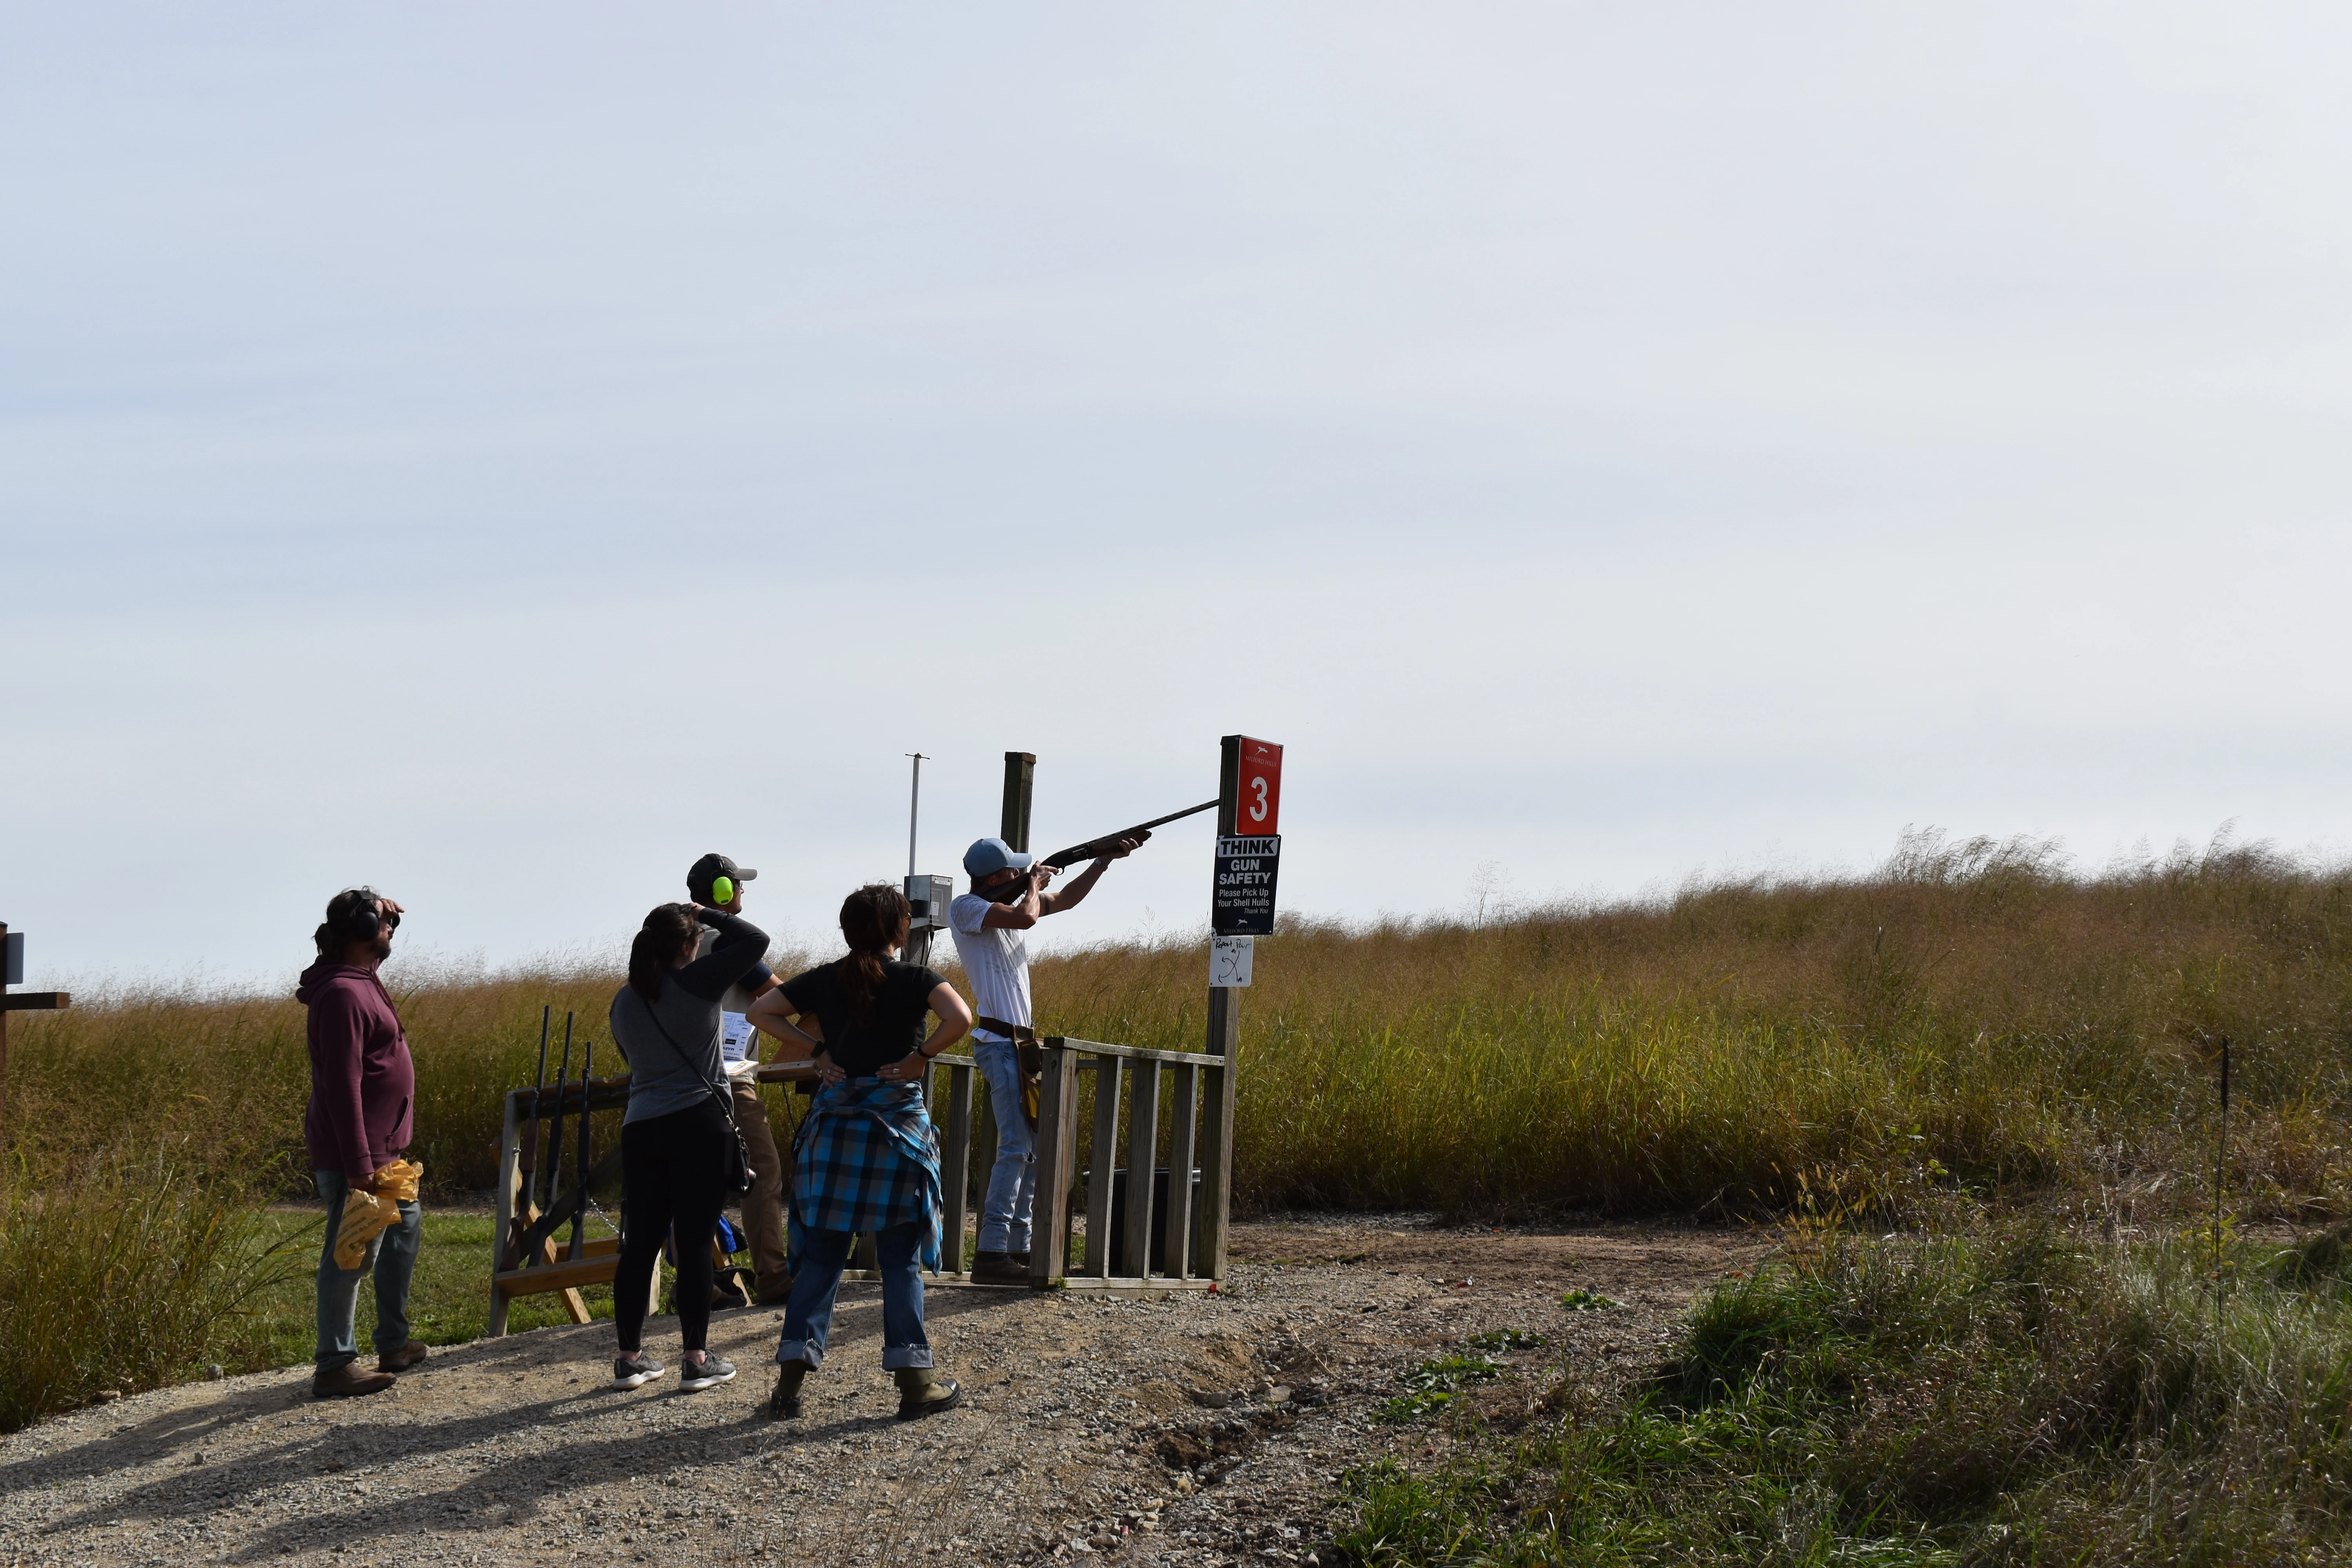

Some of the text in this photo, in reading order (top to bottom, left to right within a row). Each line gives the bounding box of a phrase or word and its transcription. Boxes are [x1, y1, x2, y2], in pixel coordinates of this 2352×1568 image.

[1245, 755, 1264, 764] MILFORD
[1250, 777, 1267, 822] 3
[1221, 840, 1274, 855] THINK
[1231, 859, 1260, 871] GUN
[1219, 872, 1271, 885] SAFETY
[1219, 888, 1269, 898] Please Pick Up
[1233, 898, 1250, 907] Shell
[1252, 898, 1269, 906] Hulls
[1236, 938, 1251, 949] Pair
